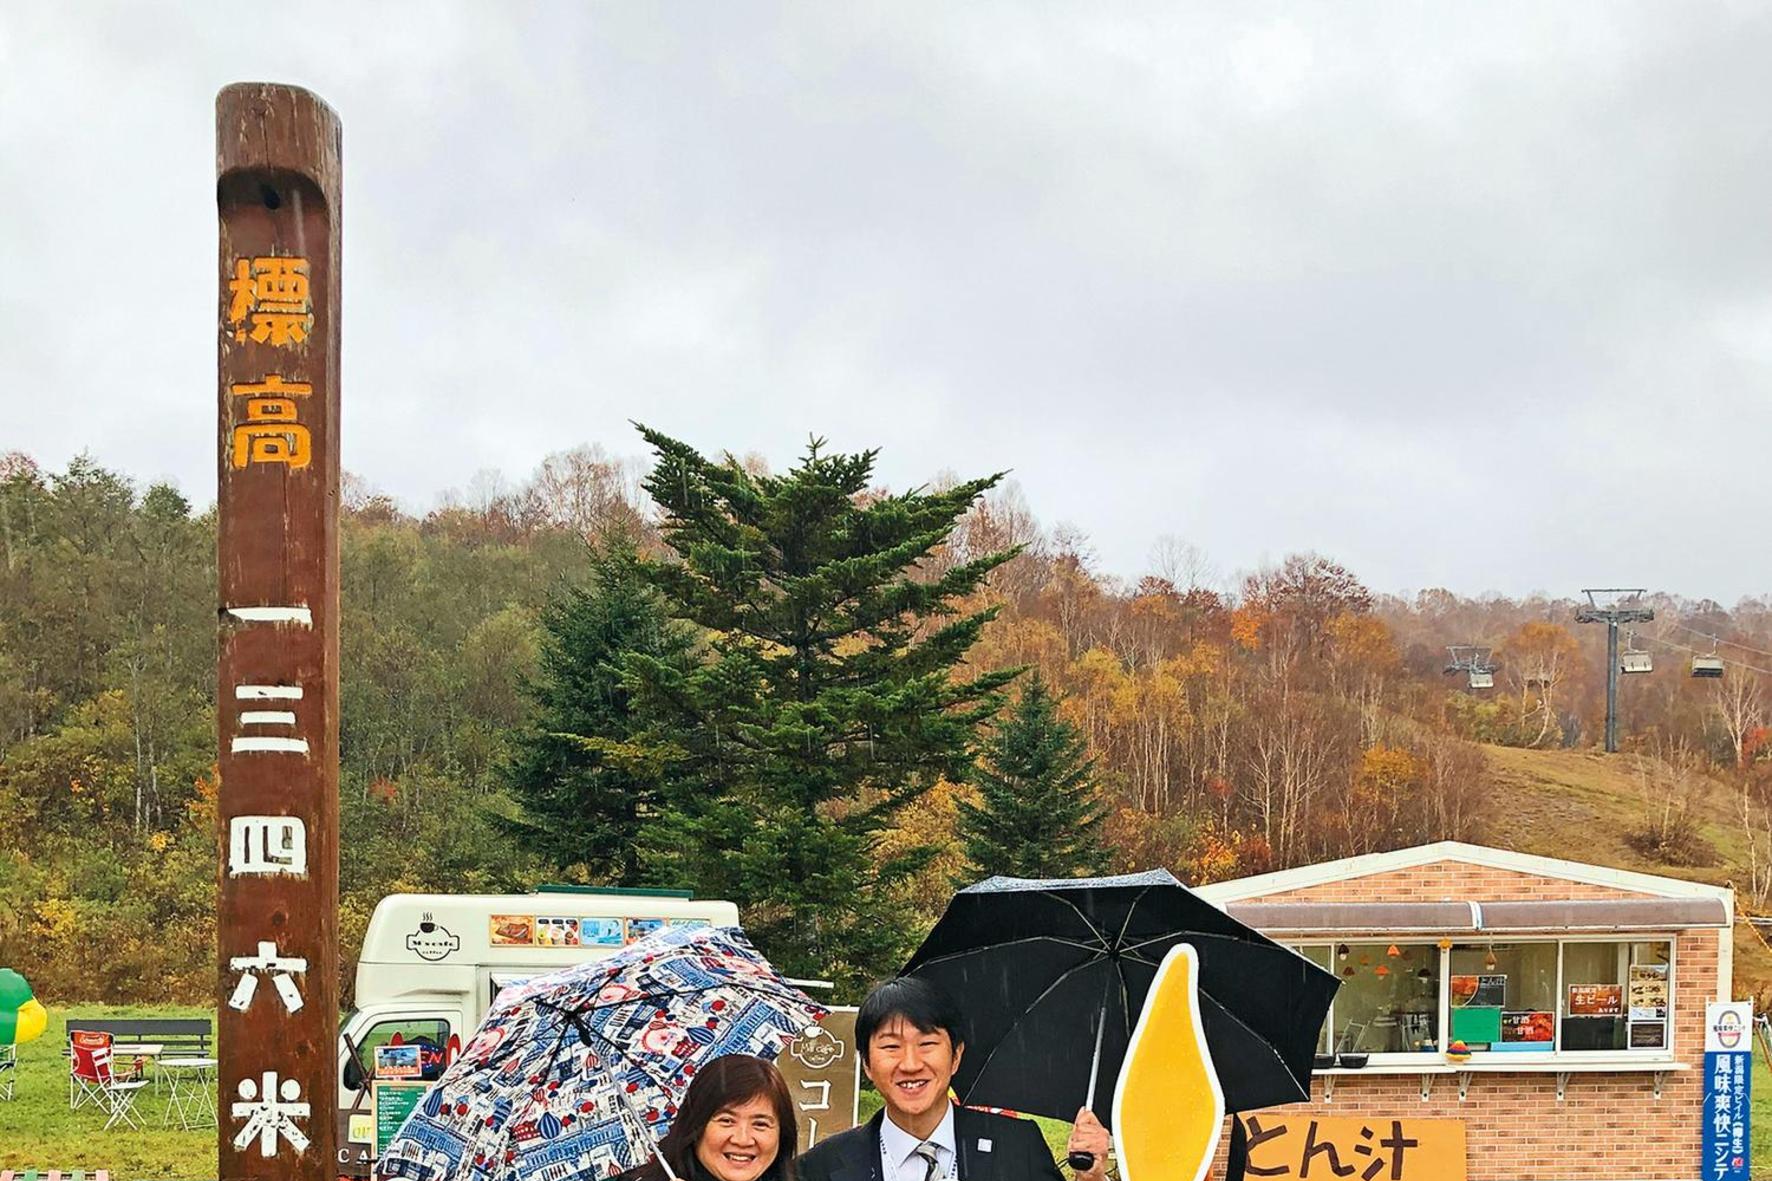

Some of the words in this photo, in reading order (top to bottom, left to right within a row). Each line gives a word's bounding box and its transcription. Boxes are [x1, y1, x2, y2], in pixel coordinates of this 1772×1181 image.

[229, 256, 314, 469] 標高
[1575, 994, 1619, 1005] 生ビール
[1713, 1054, 1733, 1181] 風味爽快ニシテ
